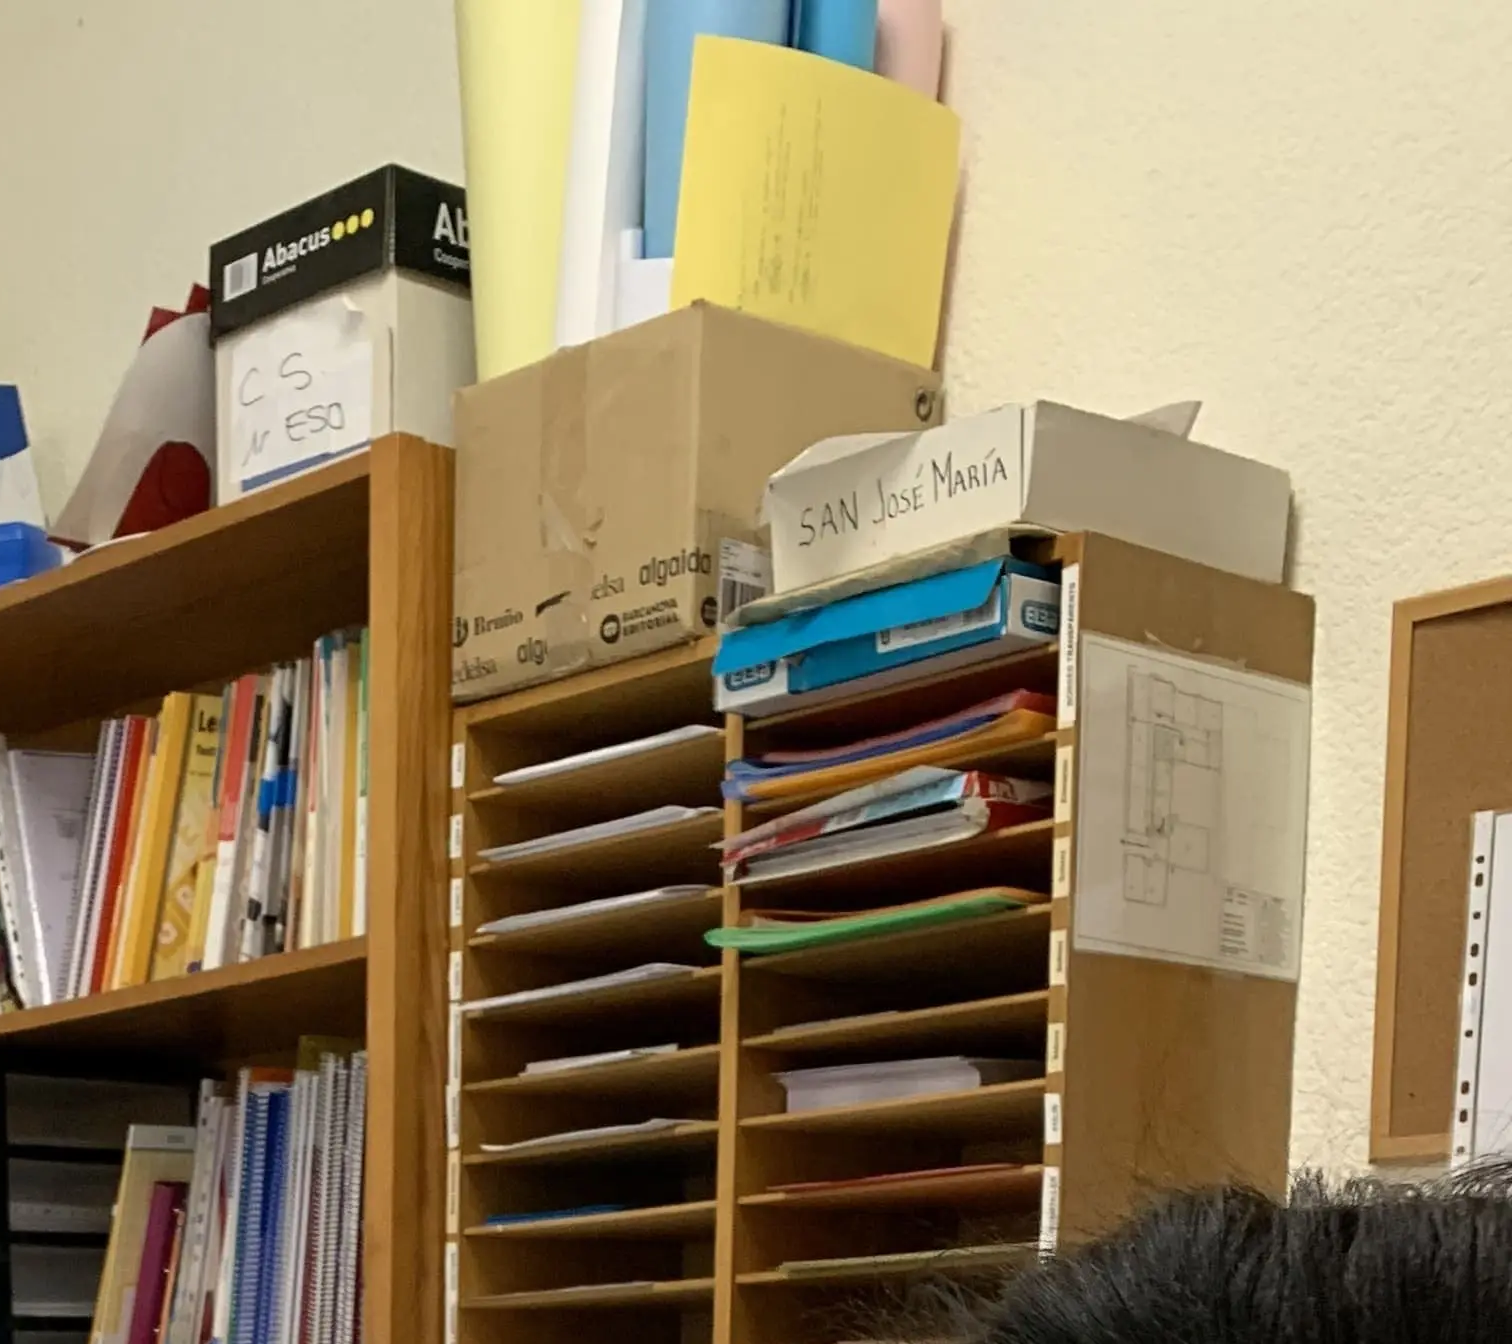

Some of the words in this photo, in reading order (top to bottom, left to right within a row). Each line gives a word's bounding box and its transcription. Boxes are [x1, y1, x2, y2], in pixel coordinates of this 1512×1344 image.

[262, 225, 331, 273] Abacus
[285, 402, 345, 441] ESO
[799, 491, 859, 547] SAN
[639, 547, 712, 588] algaida
[474, 608, 524, 636] Bruño
[622, 612, 680, 637] EDITORIAL
